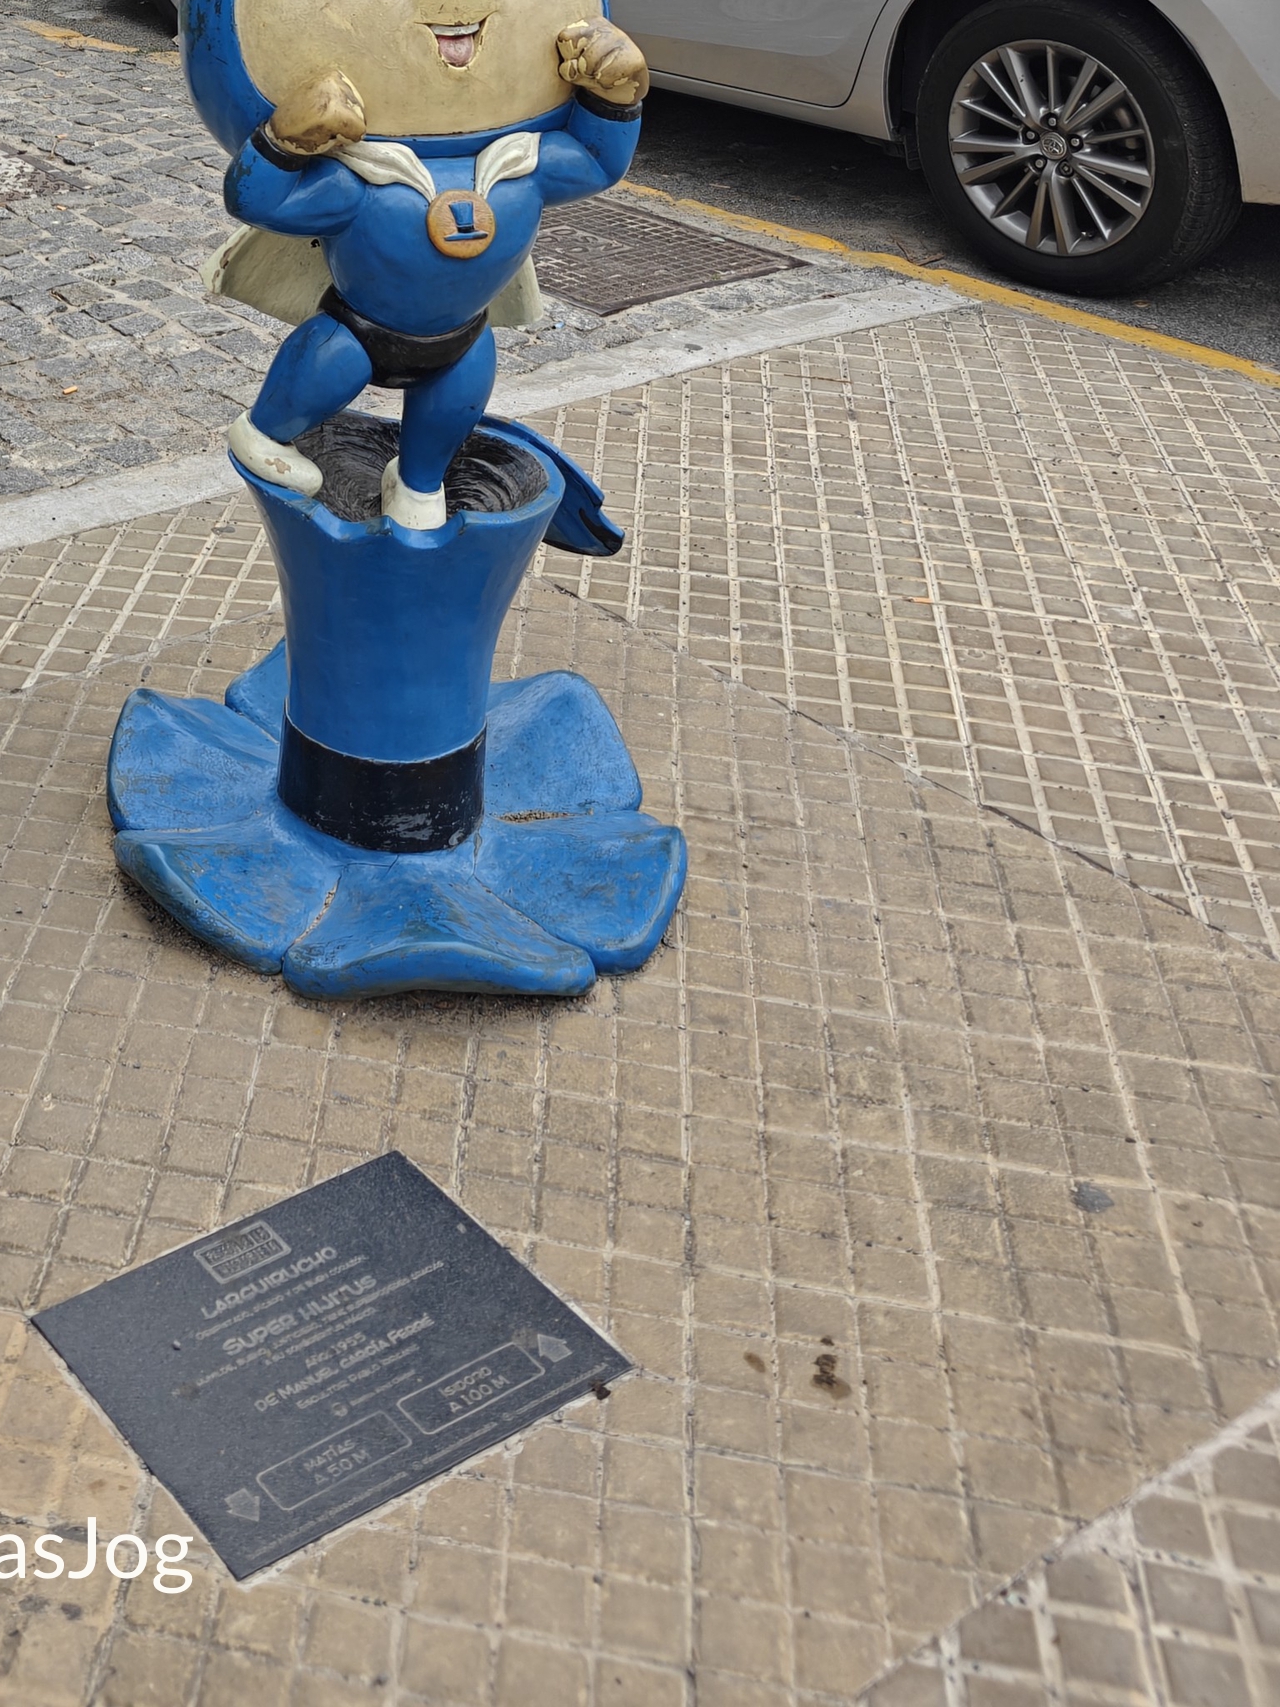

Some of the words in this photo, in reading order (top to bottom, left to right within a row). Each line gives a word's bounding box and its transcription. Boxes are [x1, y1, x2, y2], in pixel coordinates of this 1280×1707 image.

[195, 1244, 342, 1321] LARGUIRUCHO
[217, 1309, 300, 1358] SUPER
[329, 1330, 369, 1355] 1955
[251, 1390, 284, 1413] DE
[274, 1361, 341, 1400] MANUEL
[332, 1334, 391, 1370] GARCÍA
[443, 1398, 465, 1414] A
[459, 1382, 496, 1406] 100
[488, 1373, 513, 1390] M
[324, 1456, 356, 1478] 50
[349, 1447, 373, 1465] M
